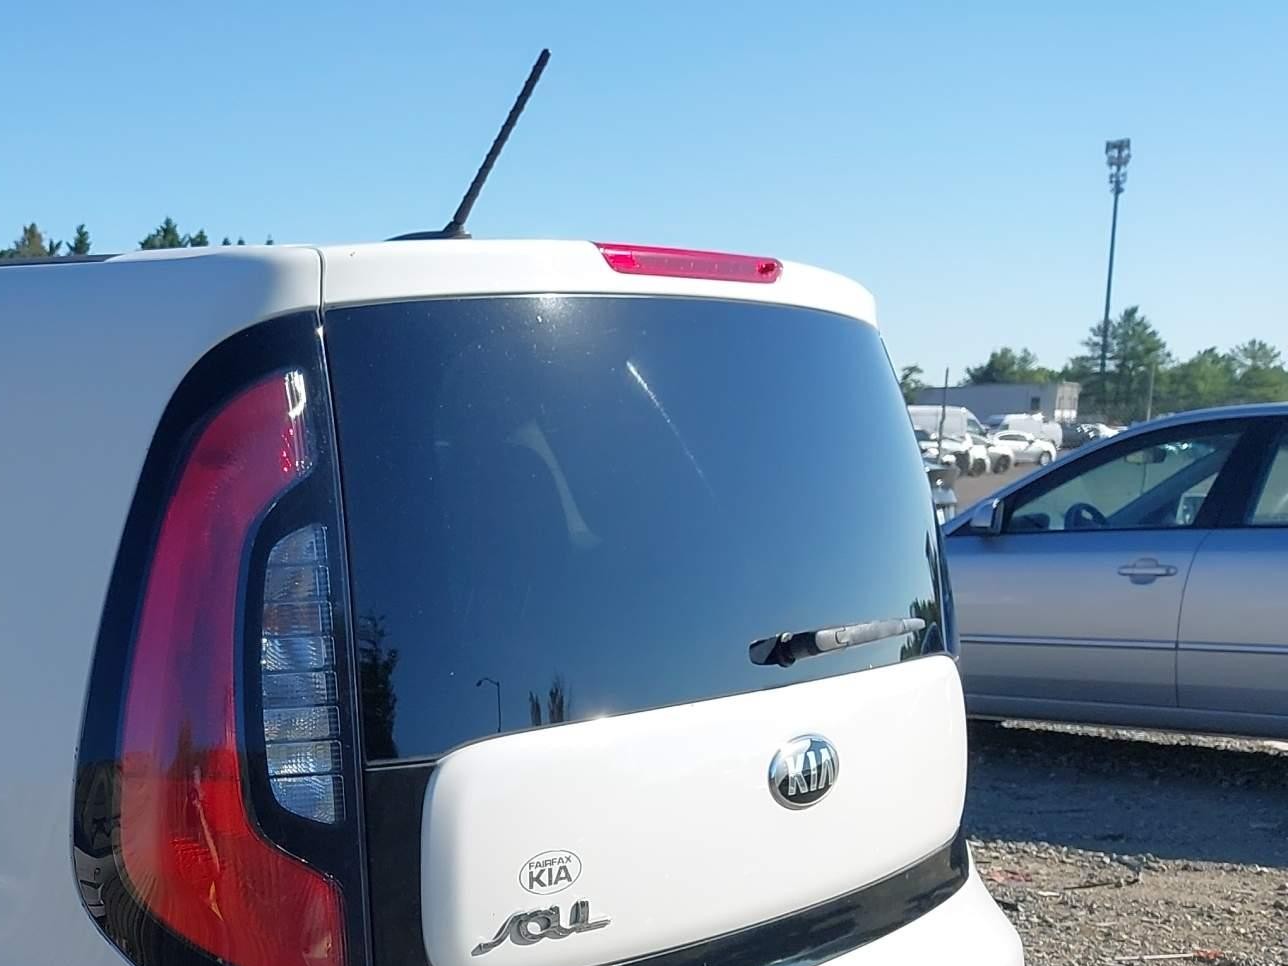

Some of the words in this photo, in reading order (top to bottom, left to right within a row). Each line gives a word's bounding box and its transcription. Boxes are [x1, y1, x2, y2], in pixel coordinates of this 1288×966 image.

[784, 747, 833, 796] KIA
[528, 855, 572, 870] FAIRFAX
[528, 865, 572, 890] KIA
[471, 900, 611, 956] SOUL
